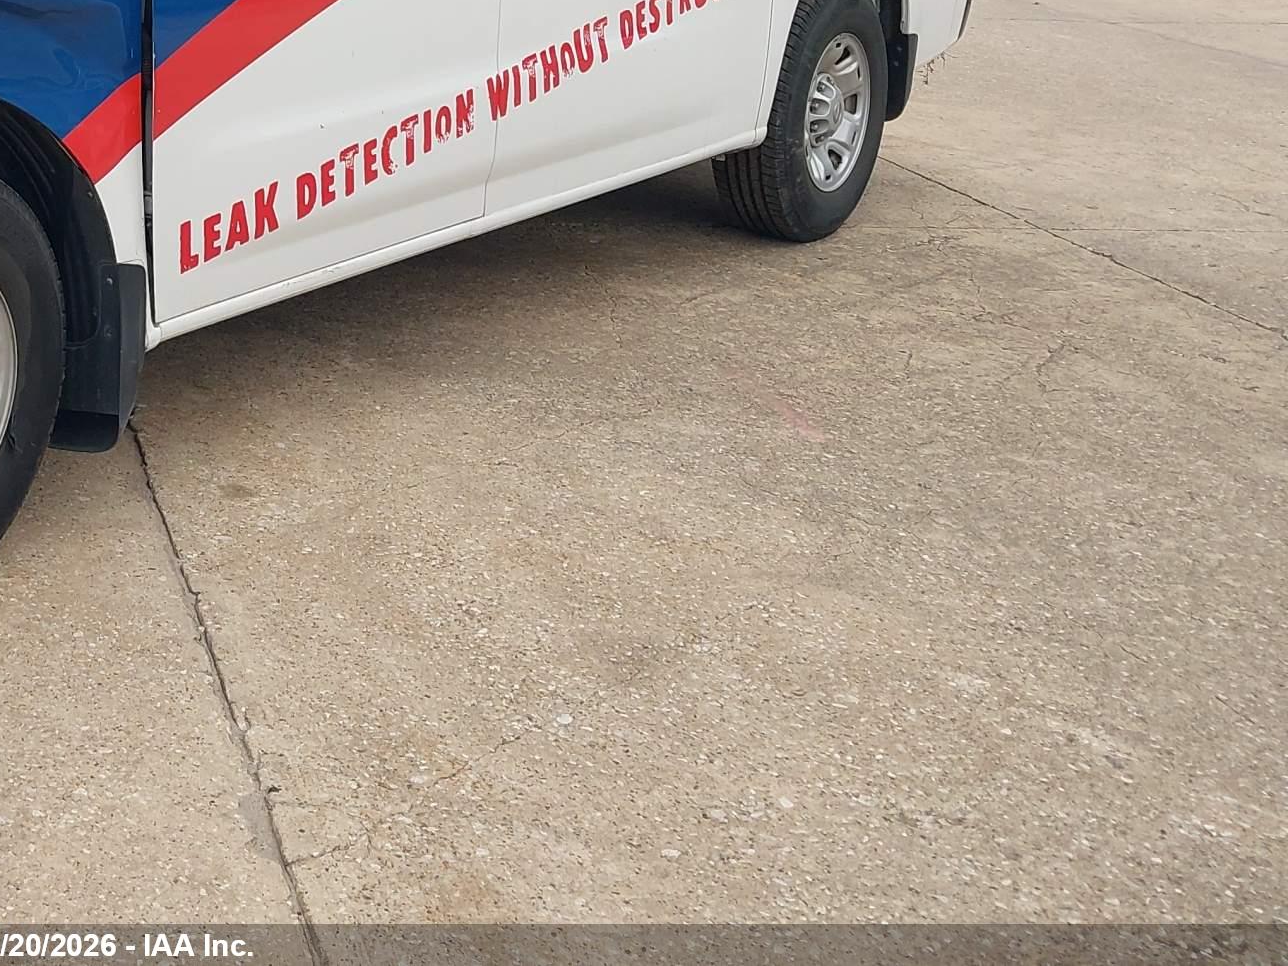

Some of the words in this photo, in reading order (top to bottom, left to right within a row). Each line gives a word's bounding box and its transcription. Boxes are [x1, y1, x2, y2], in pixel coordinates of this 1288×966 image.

[180, 181, 279, 274] LEAK
[295, 89, 476, 220] DETECTION
[486, 16, 609, 121] WITHOUT
